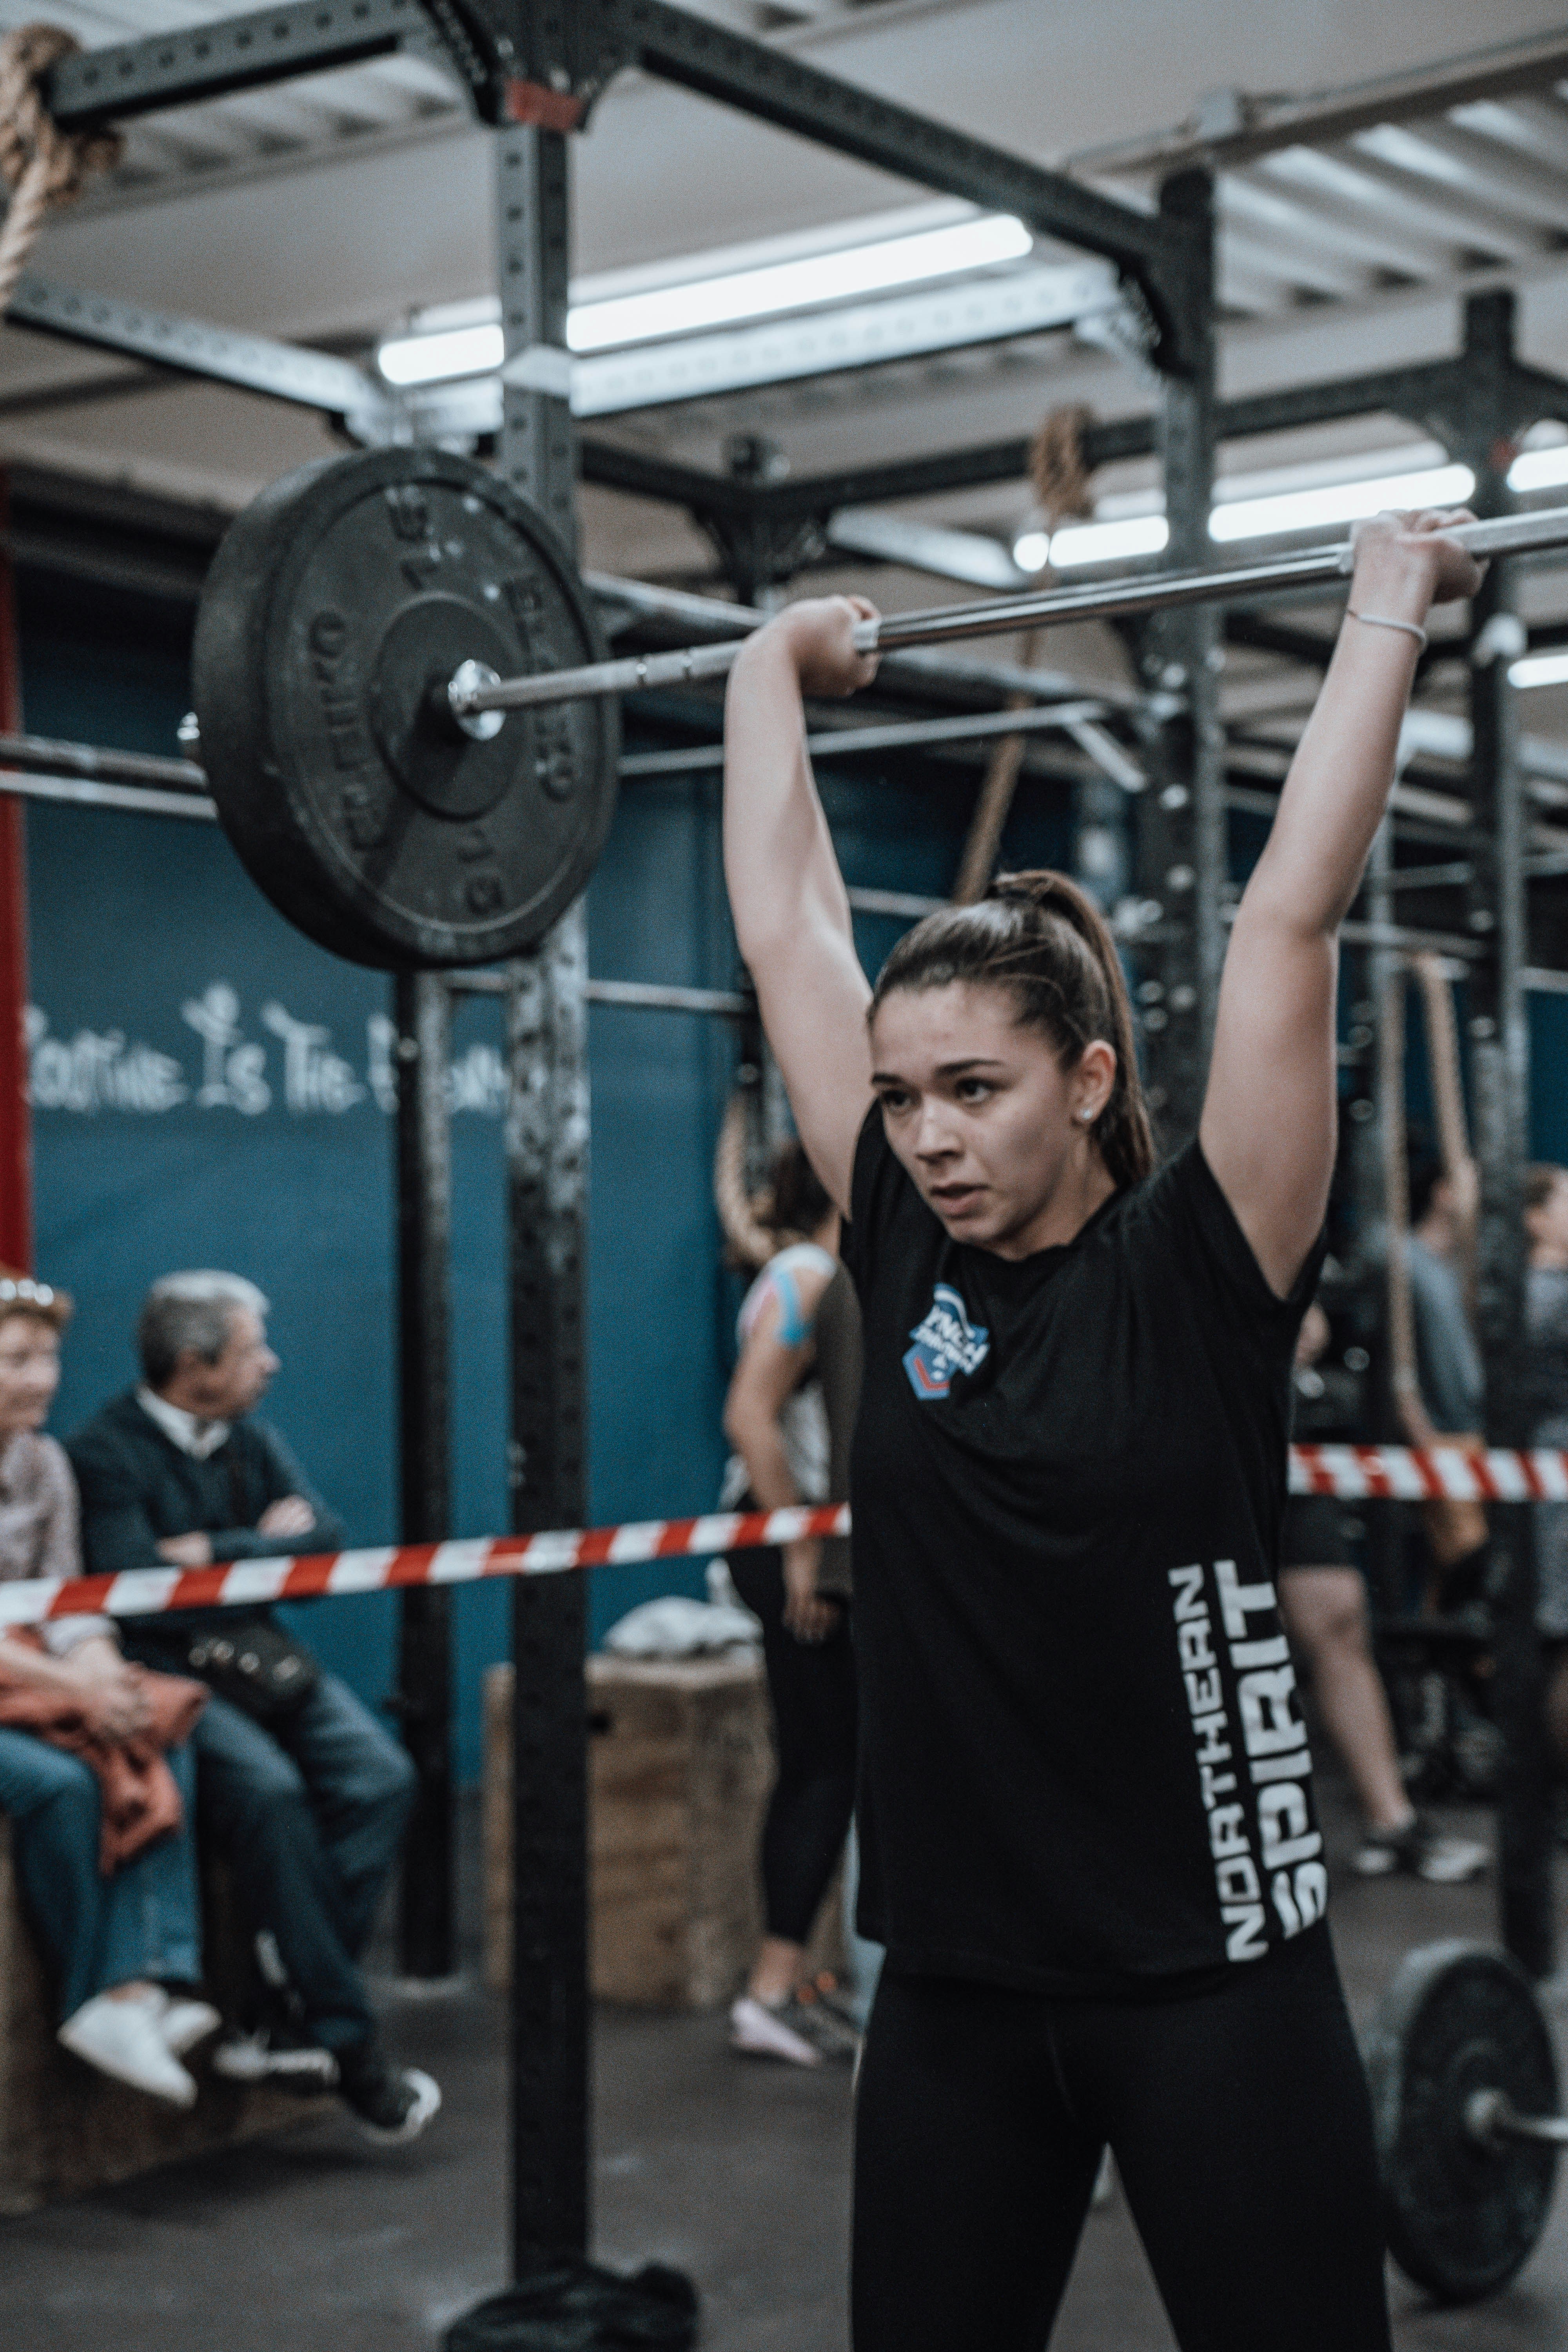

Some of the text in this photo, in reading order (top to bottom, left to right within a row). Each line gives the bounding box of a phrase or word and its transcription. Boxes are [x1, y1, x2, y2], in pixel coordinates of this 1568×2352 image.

[181, 978, 272, 1115] Is
[1168, 1564, 1269, 1962] NORTHERN
[1214, 1559, 1328, 1940] SPIRIT
